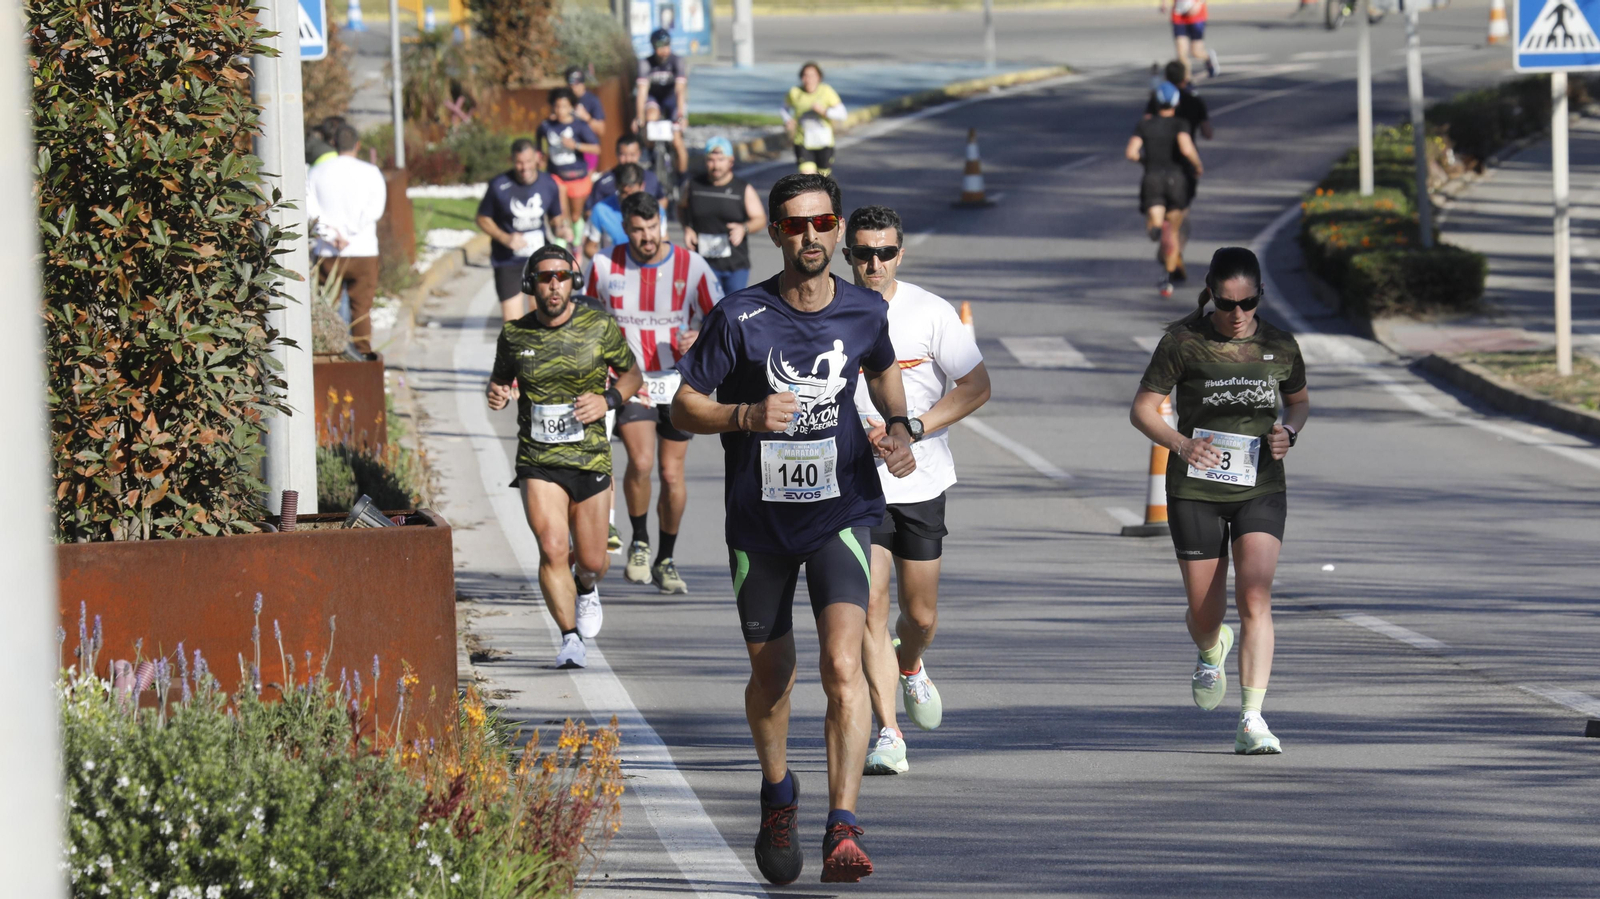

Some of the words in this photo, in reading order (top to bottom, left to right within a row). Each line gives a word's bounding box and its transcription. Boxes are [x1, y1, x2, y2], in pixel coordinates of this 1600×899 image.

[1204, 377, 1267, 388] #buscatulocura
[797, 404, 840, 427] RATÓN
[540, 418, 566, 434] 180
[778, 463, 818, 487] 140
[1205, 471, 1239, 482] EVOS
[783, 491, 822, 500] EVOS
